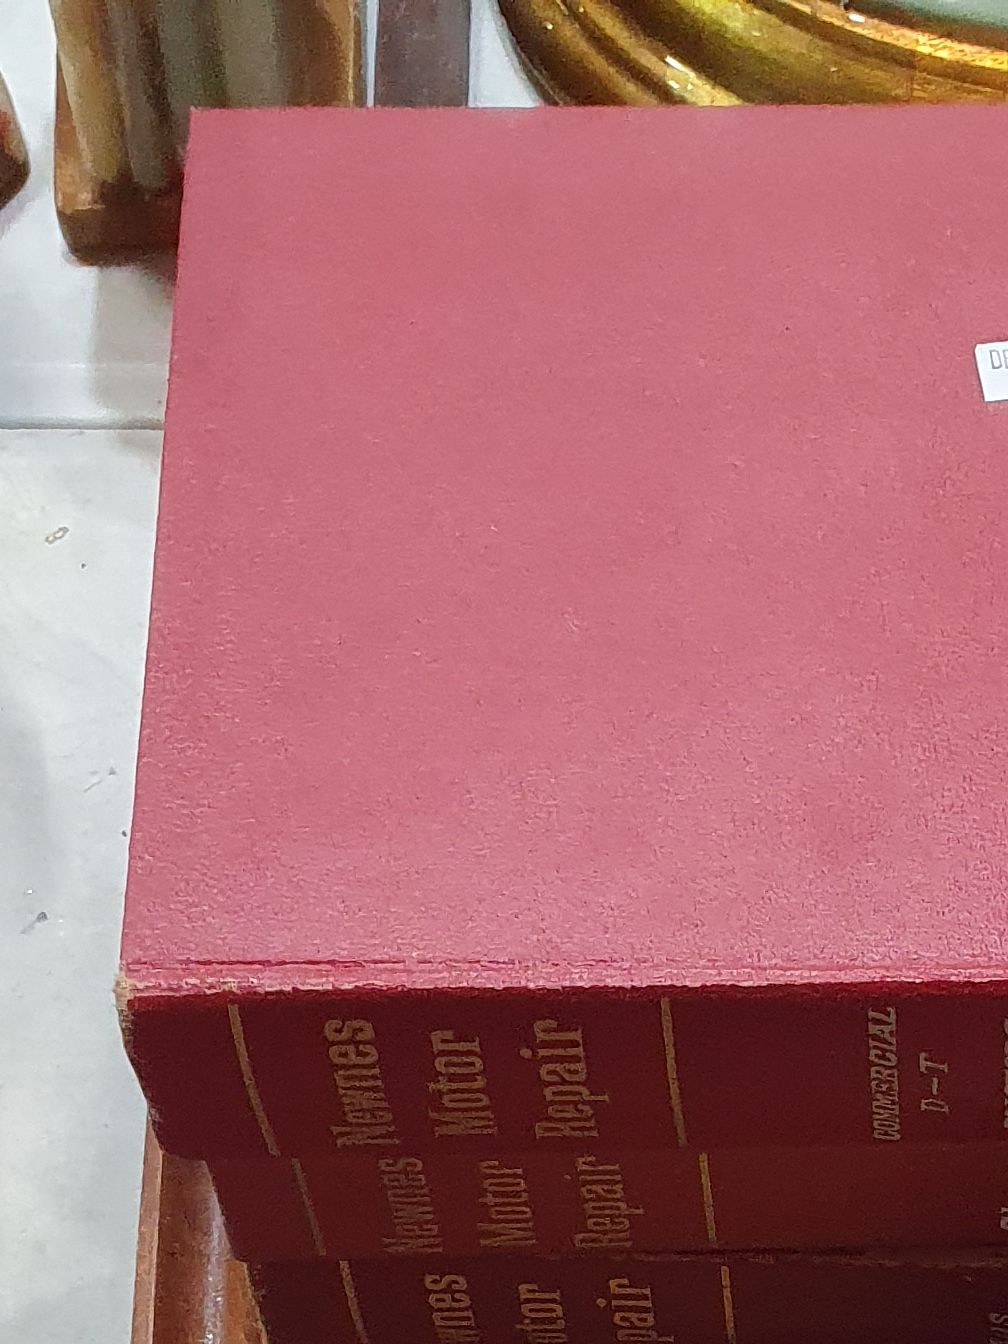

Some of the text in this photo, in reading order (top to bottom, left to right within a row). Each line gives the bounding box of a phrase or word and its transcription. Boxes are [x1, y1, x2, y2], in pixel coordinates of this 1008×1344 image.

[324, 1017, 400, 1148] Newnes
[427, 1029, 495, 1138] Motor
[520, 1019, 610, 1139] Repair
[868, 1006, 901, 1142] COMMERCIAL
[379, 1156, 443, 1253] Newnes
[478, 1159, 537, 1248] Motor
[563, 1155, 644, 1249] Repair
